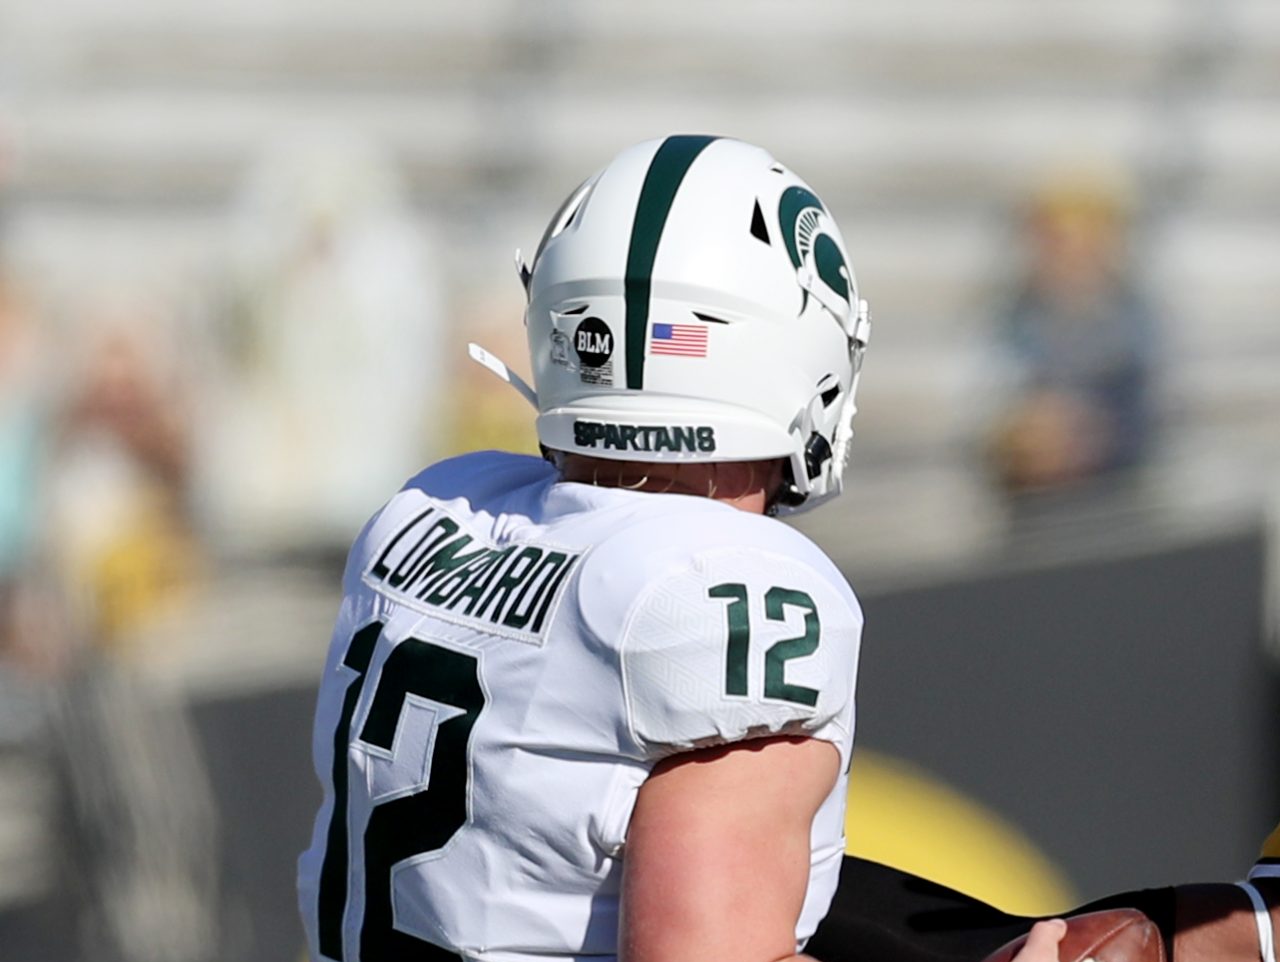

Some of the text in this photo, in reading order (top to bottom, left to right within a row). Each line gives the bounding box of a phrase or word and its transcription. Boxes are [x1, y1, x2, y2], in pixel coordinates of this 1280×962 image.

[577, 331, 610, 354] BLM
[573, 420, 716, 452] SPARTANS
[371, 507, 579, 633] LOMBARDI
[708, 583, 821, 707] 12
